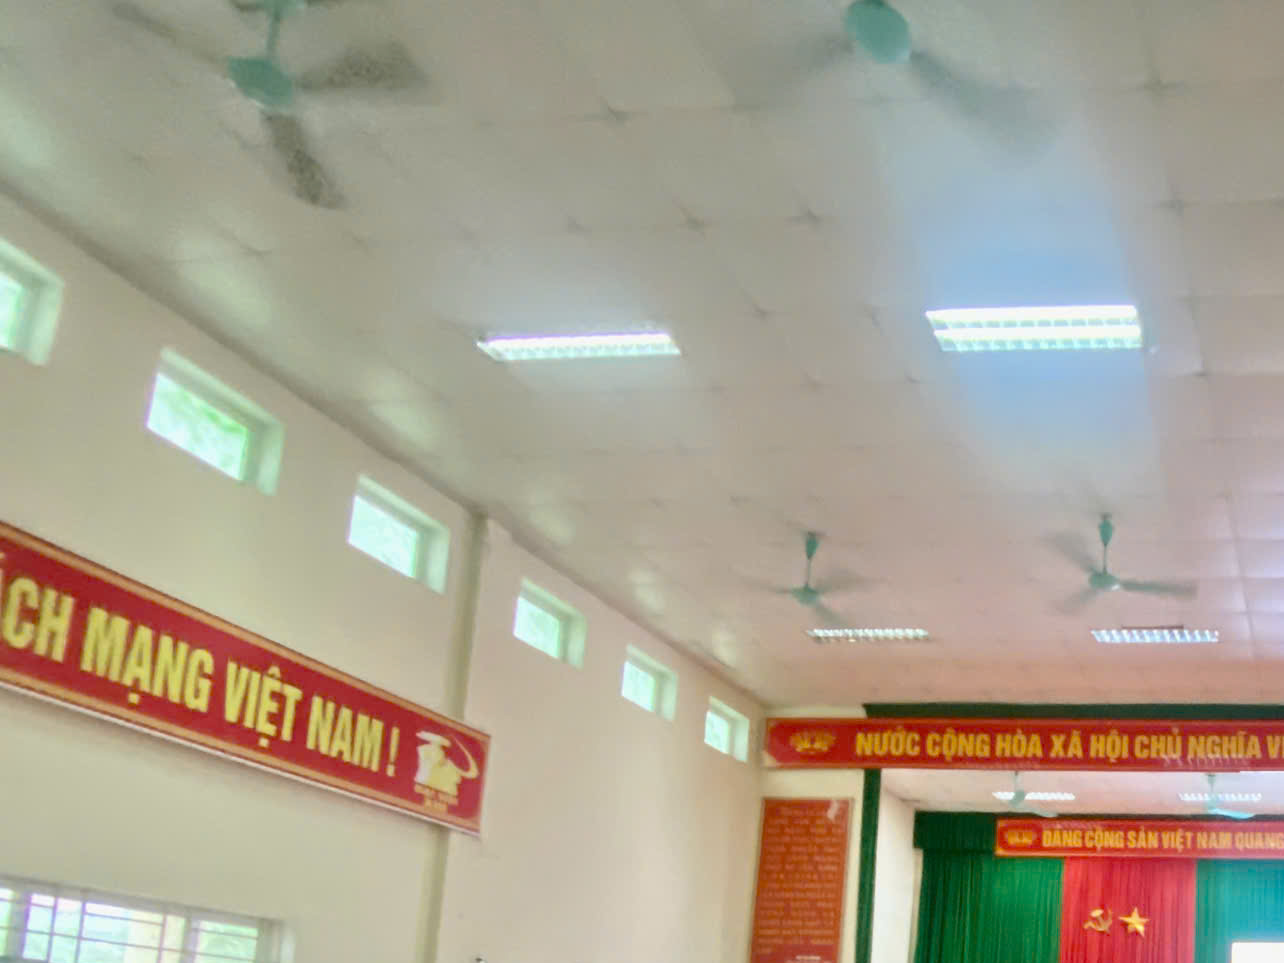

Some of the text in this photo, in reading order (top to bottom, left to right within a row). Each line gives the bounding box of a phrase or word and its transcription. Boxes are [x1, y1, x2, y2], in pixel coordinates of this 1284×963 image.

[0, 552, 74, 664] CH
[80, 606, 214, 713] MẠNG
[223, 657, 302, 748] VIỆT
[306, 695, 384, 773] NAM
[855, 726, 921, 757] NƯỚC
[926, 727, 991, 762] CỘNG
[995, 728, 1043, 758] HÒA
[1051, 729, 1083, 759] XÃ
[1089, 729, 1129, 763] HỘI
[1134, 727, 1182, 759] CHỦ
[1187, 730, 1262, 760] NGHĨA
[1161, 828, 1193, 853] VIỆT
[1196, 831, 1233, 849] NAM
